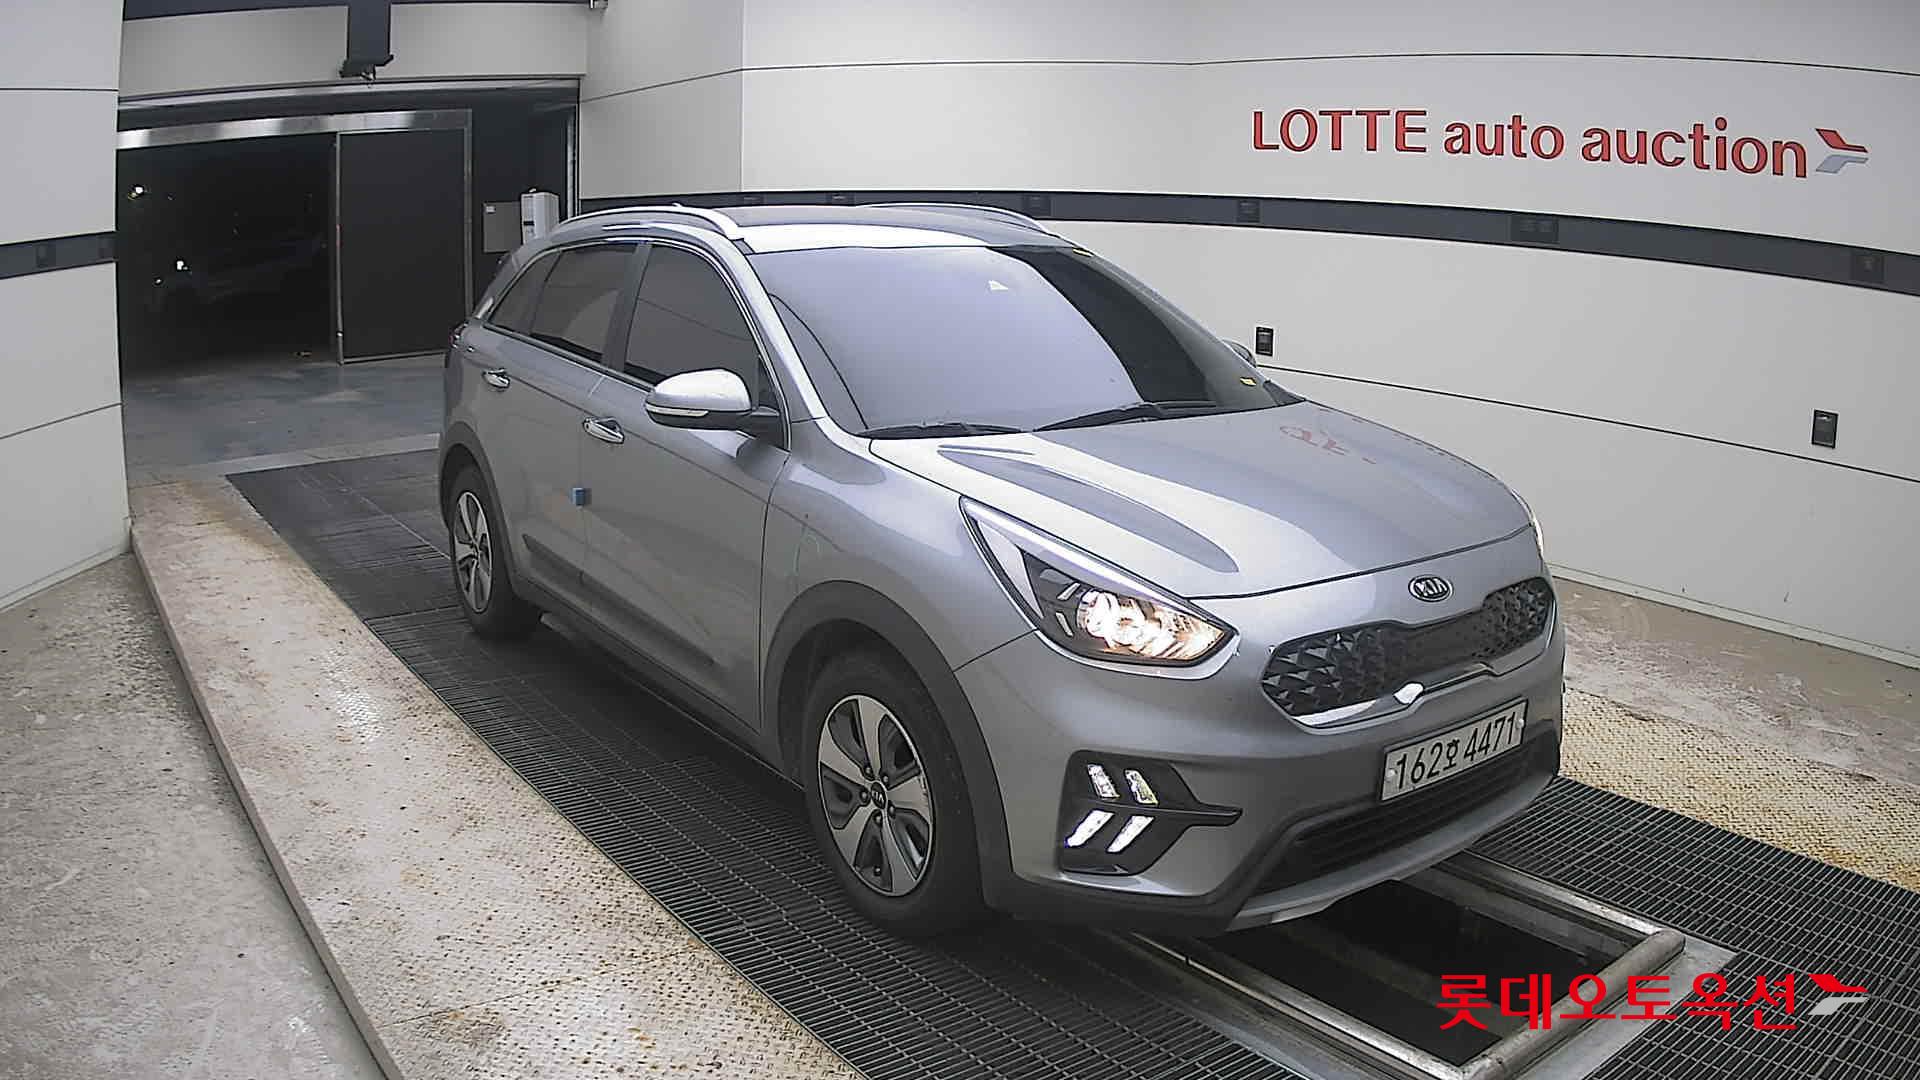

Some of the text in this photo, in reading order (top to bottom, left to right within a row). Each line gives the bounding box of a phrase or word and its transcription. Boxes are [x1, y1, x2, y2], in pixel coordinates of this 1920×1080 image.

[1252, 109, 1808, 179] LOTTE auto auction
[1414, 577, 1448, 597] KIA
[1463, 711, 1516, 762] 4471
